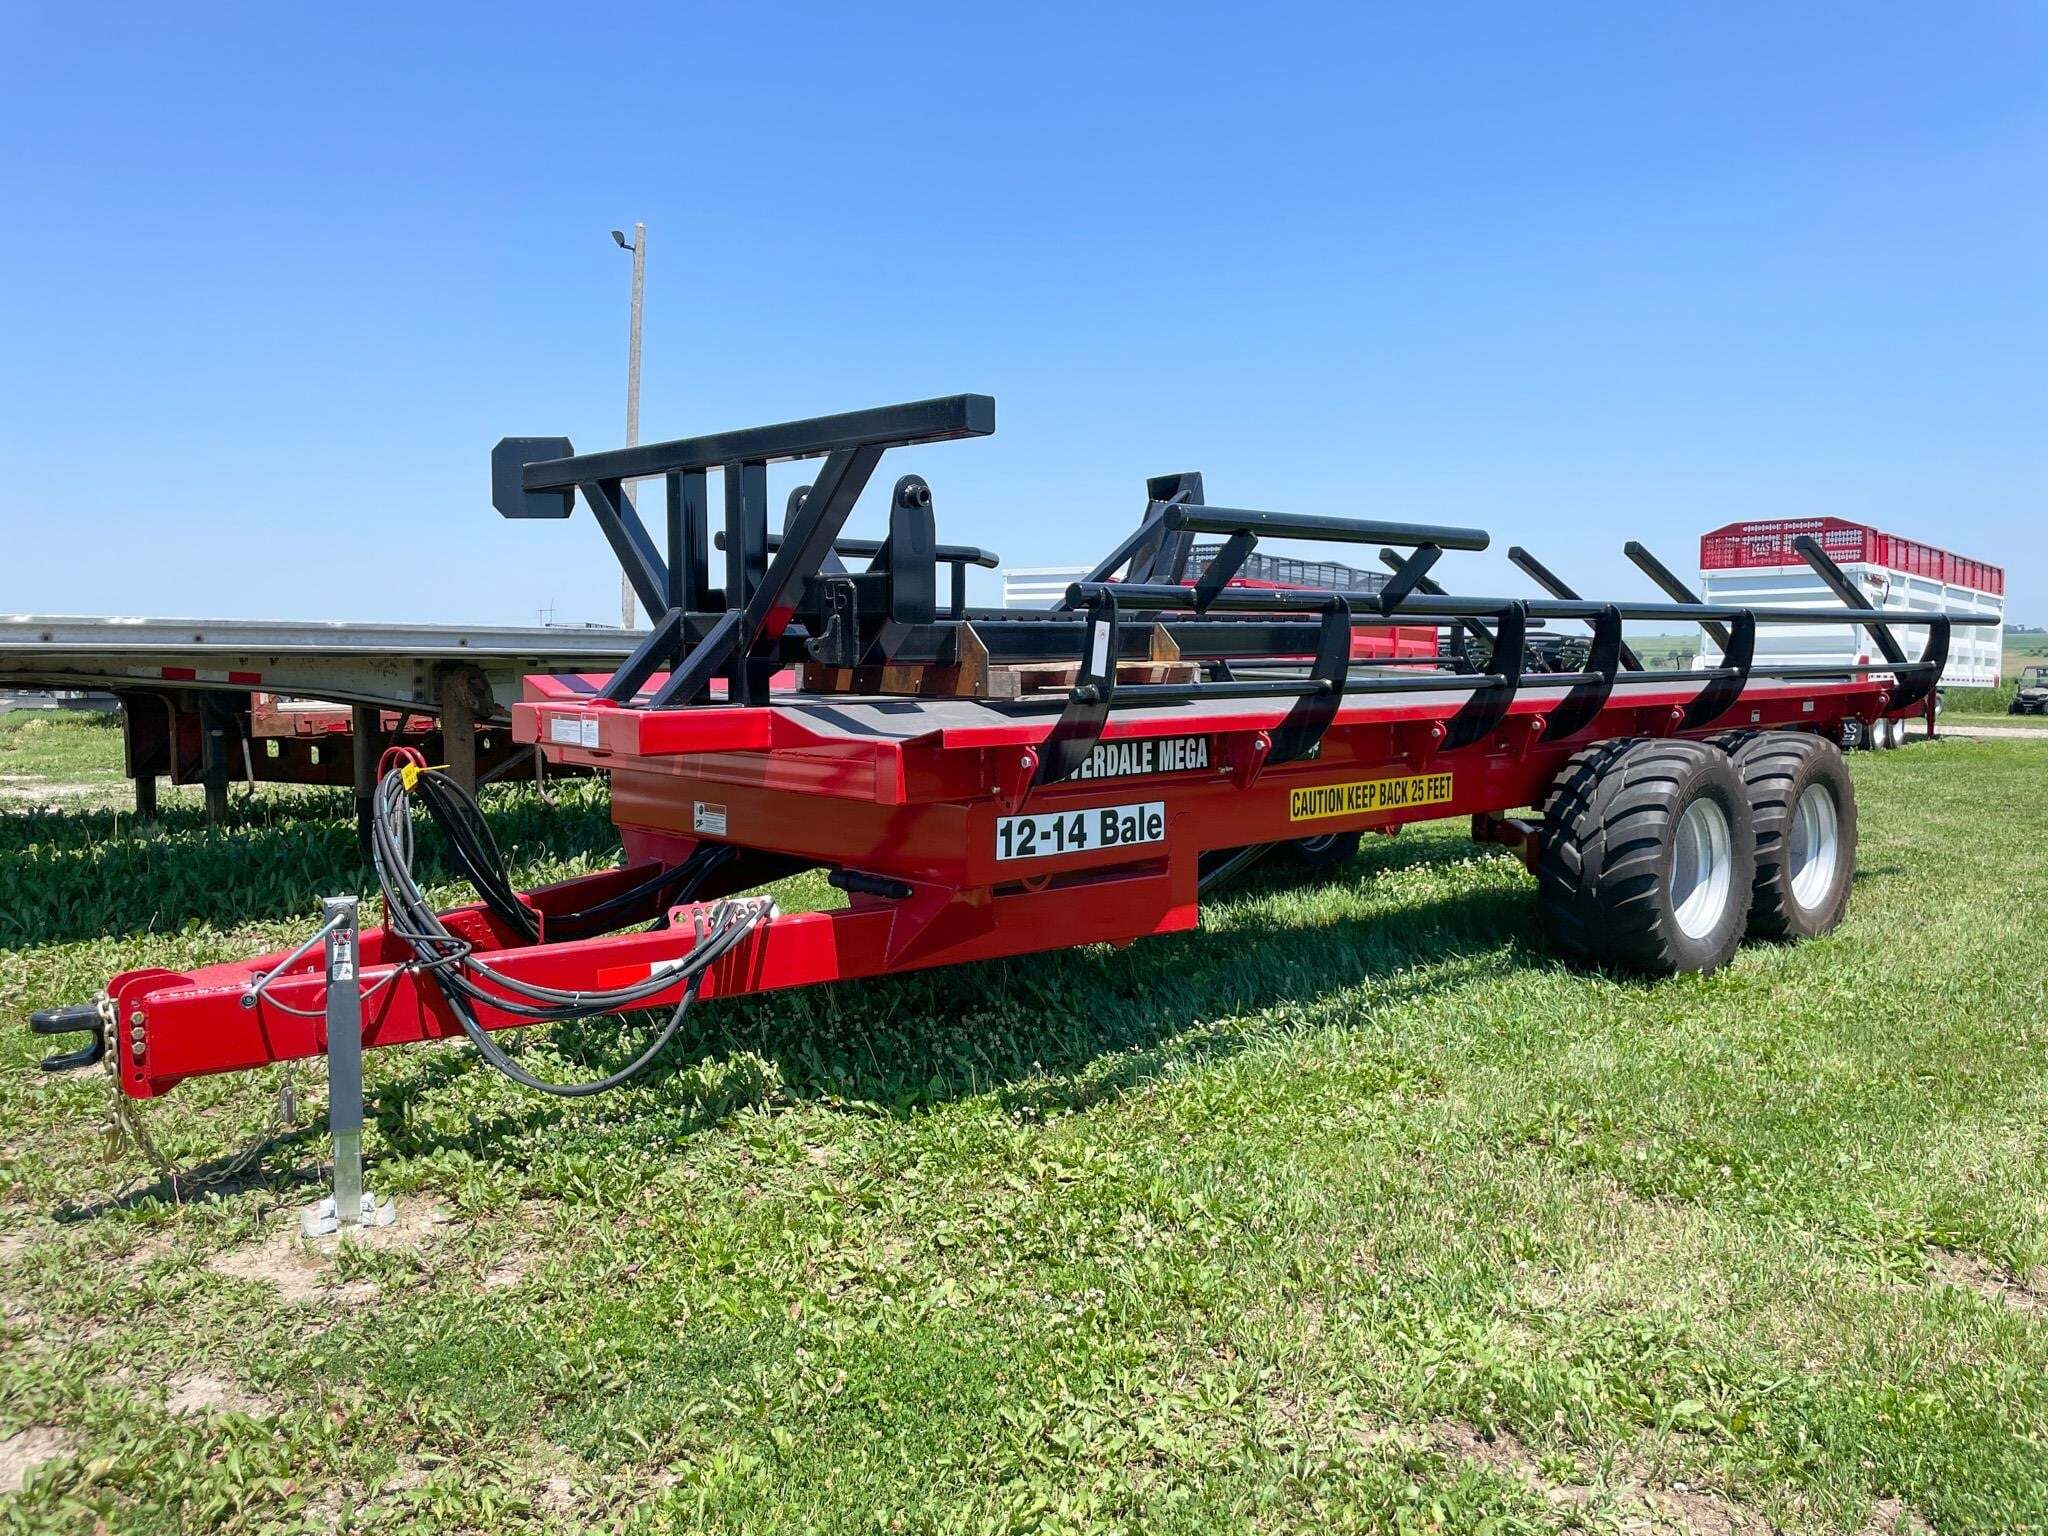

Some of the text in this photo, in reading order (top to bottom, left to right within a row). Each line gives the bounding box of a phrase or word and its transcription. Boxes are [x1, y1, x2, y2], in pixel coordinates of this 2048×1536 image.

[1159, 738, 1208, 771] MEGA
[1292, 776, 1452, 817] CAUTION KEEP BACK 25 FEET
[1000, 806, 1163, 857] 12-14 Bale
